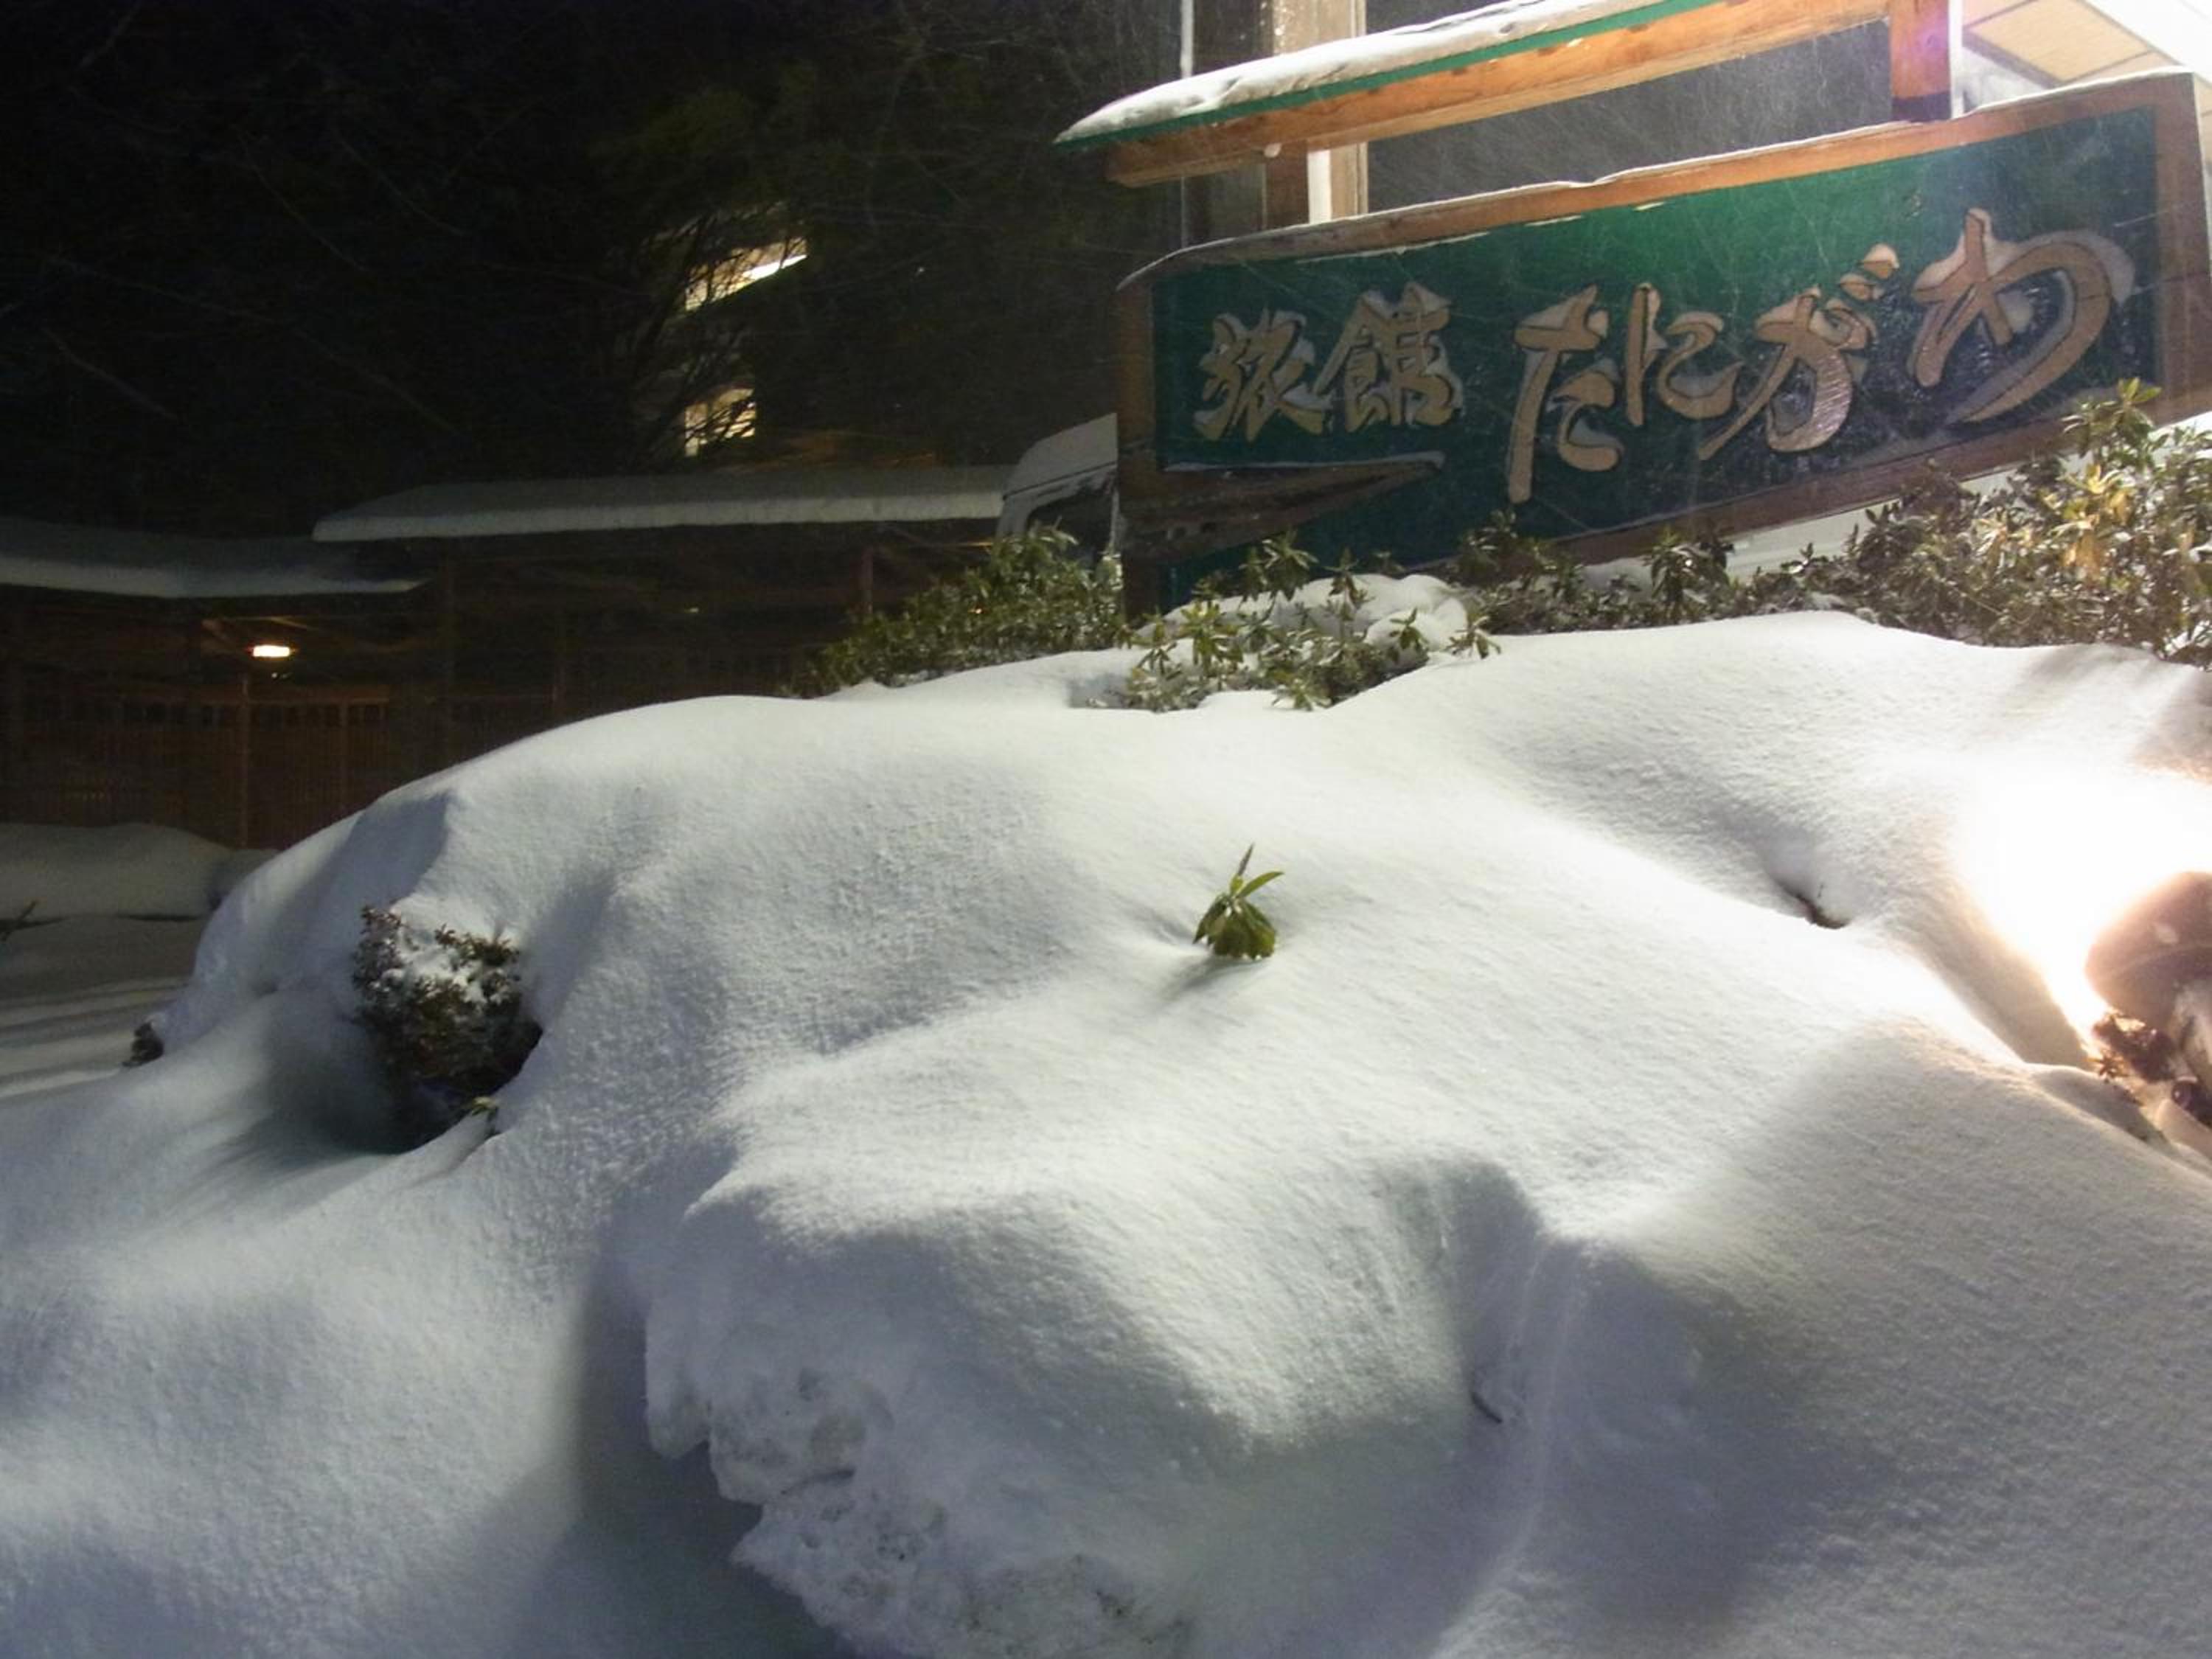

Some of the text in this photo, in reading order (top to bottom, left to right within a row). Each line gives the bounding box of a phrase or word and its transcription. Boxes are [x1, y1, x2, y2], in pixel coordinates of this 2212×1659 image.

[1193, 208, 2134, 503] 旅館 たにがわ
